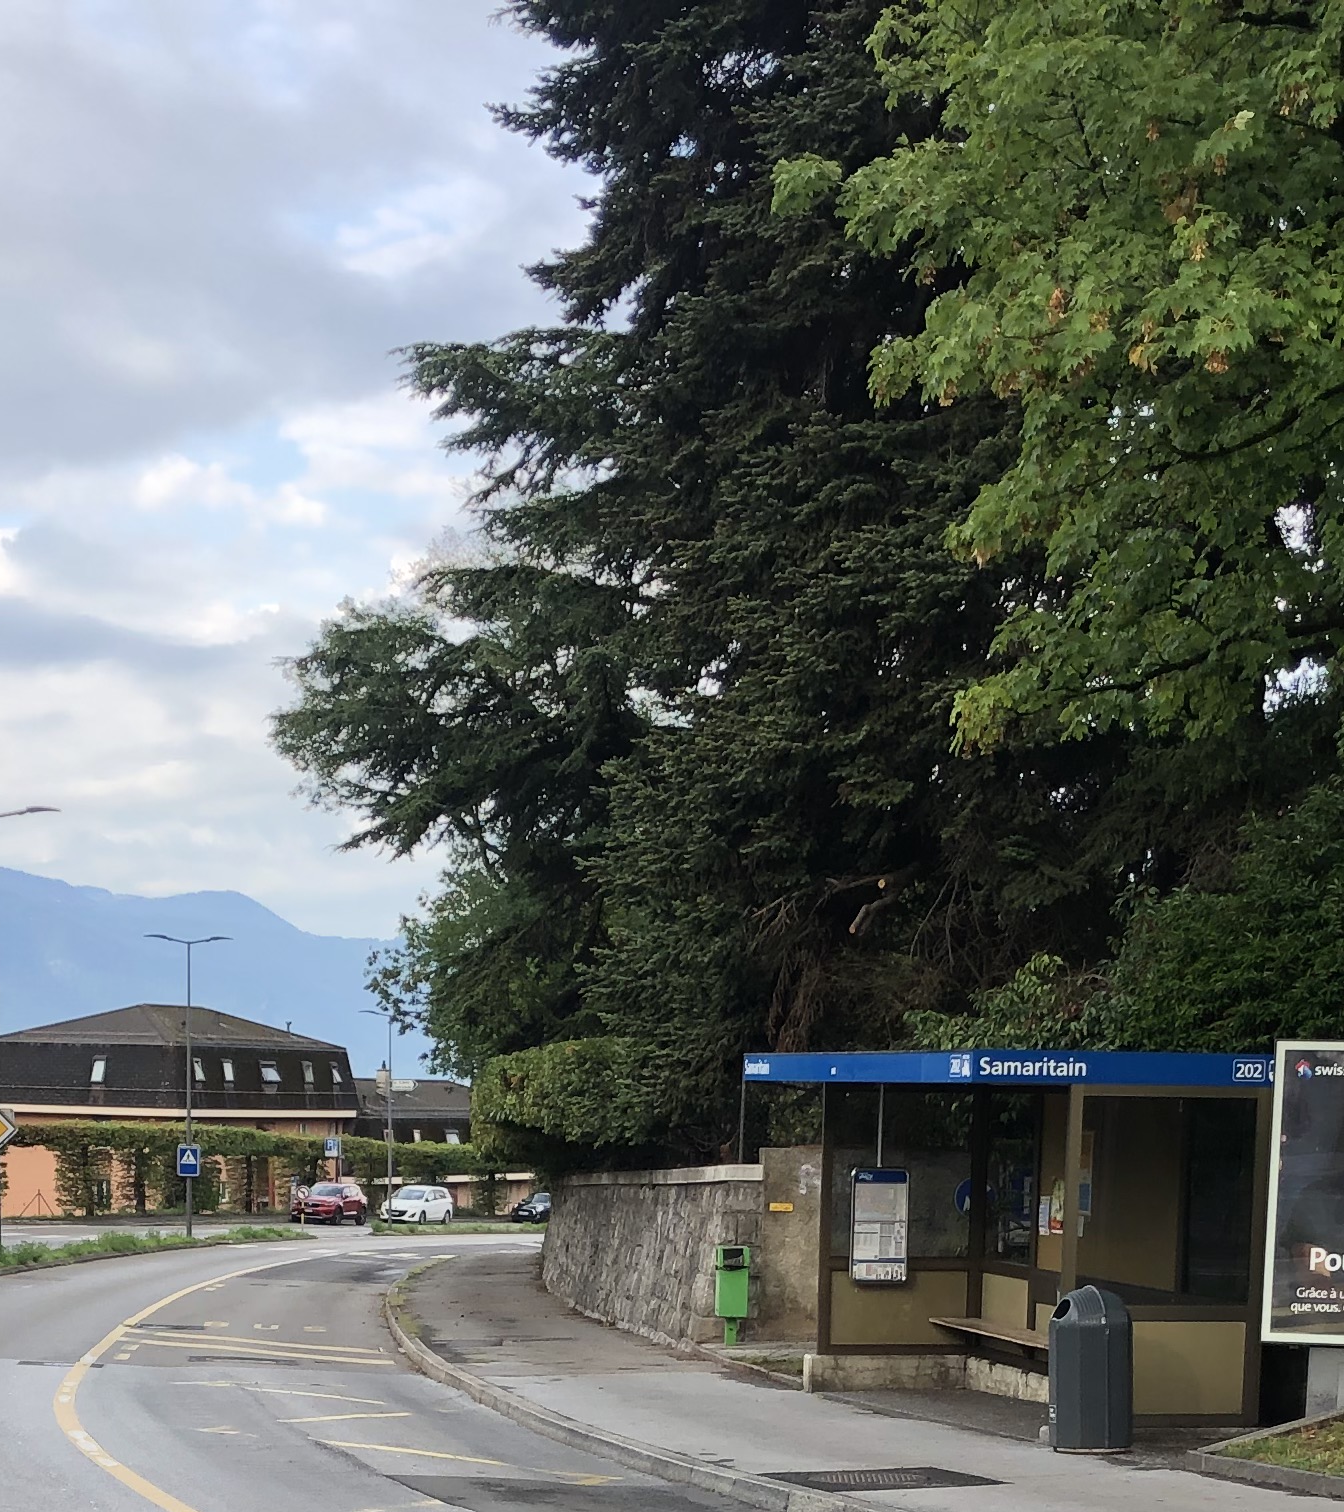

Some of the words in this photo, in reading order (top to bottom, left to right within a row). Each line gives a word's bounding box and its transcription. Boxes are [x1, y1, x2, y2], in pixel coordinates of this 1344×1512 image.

[979, 1056, 1088, 1077] Samaritain
[1235, 1063, 1263, 1078] 202
[1296, 1286, 1329, 1298] Grâce
[1329, 1287, 1337, 1299] à
[1290, 1302, 1312, 1314] que
[1313, 1303, 1341, 1313] vous.
